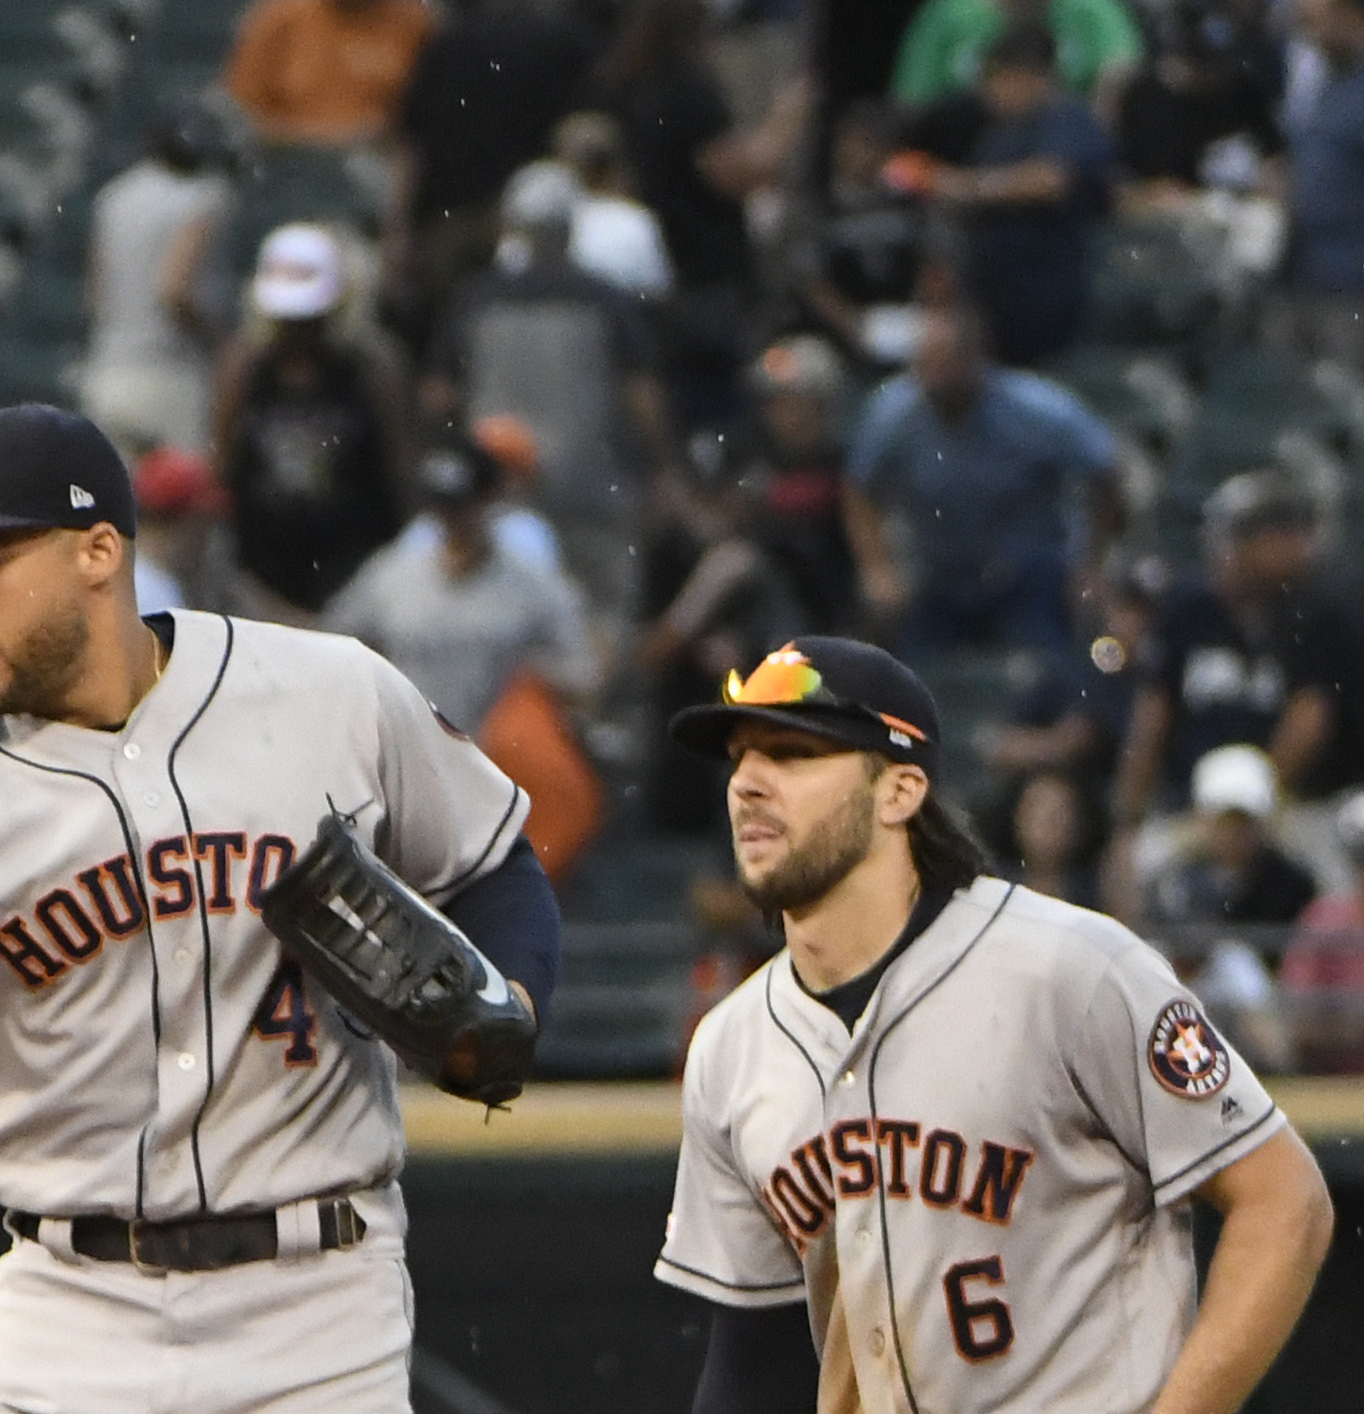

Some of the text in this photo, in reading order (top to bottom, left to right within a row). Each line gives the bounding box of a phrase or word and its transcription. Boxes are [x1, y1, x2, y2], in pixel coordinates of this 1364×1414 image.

[253, 957, 318, 1068] 4
[763, 1117, 1035, 1256] OUSTON
[942, 1255, 1016, 1366] 6
